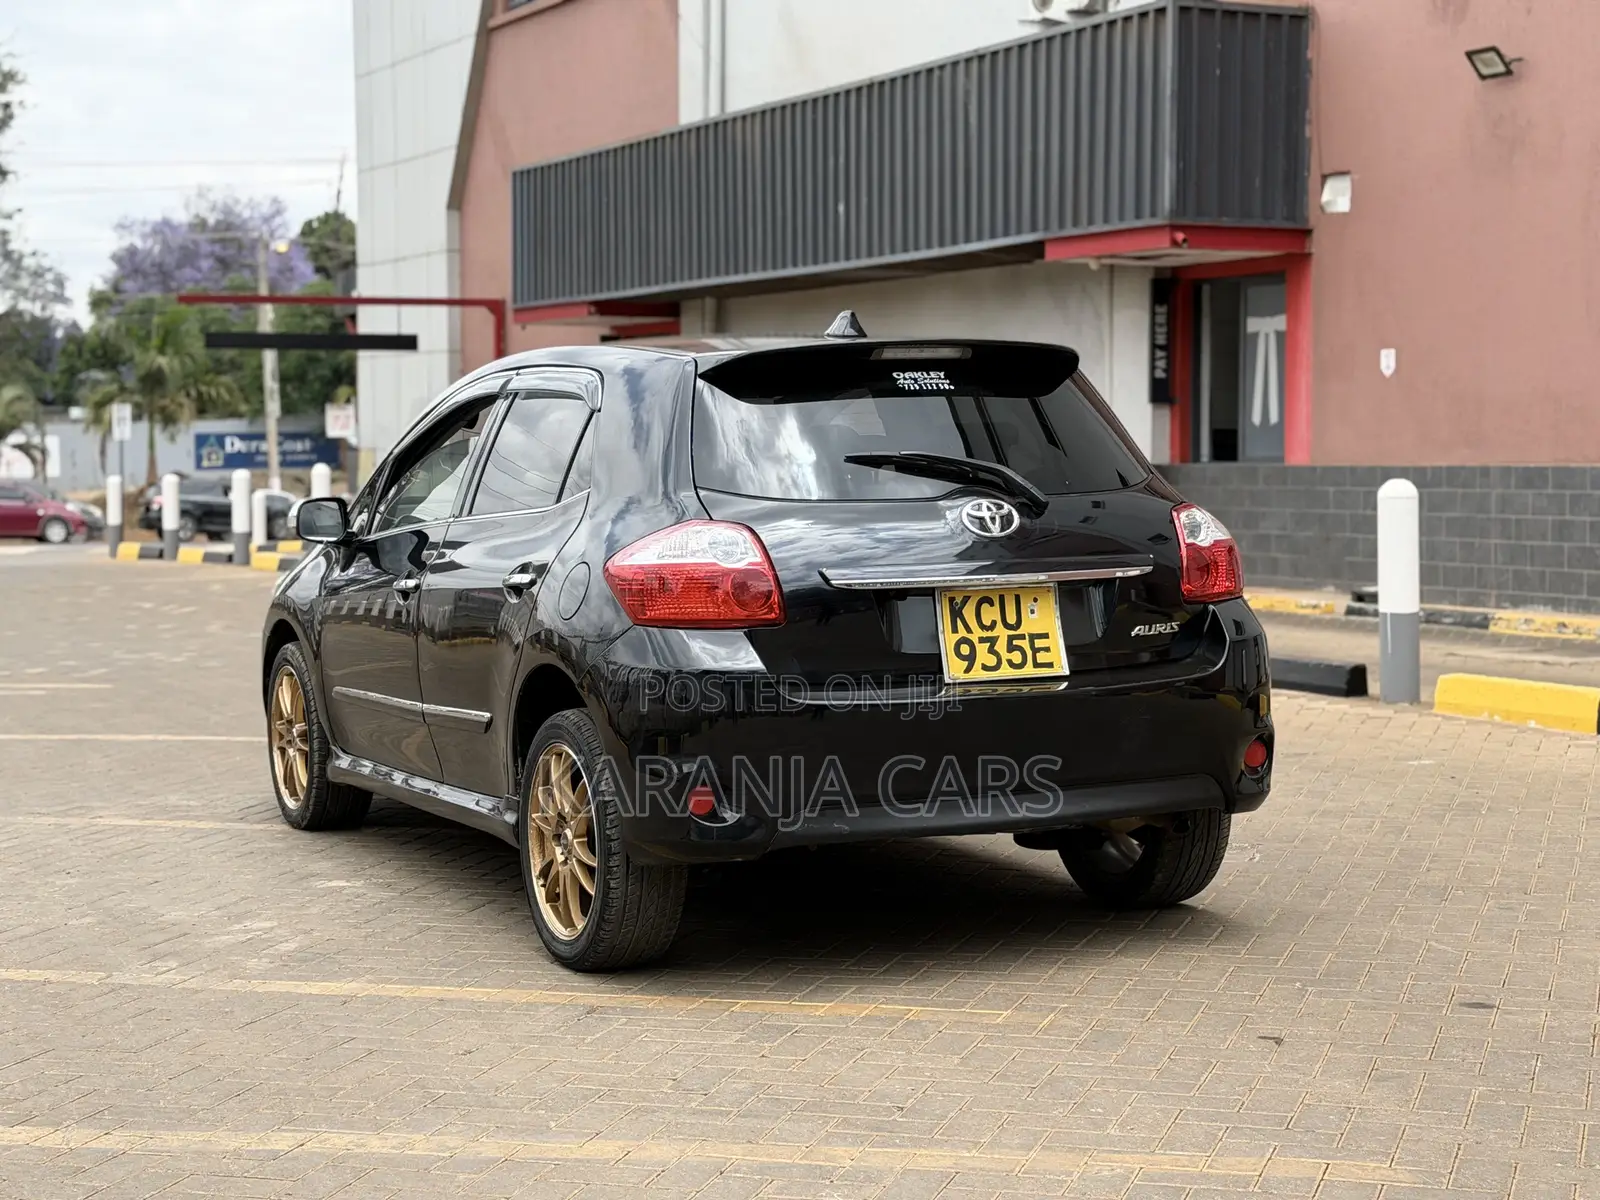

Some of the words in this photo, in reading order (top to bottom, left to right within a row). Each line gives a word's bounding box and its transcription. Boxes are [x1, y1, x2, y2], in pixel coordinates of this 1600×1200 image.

[1153, 303, 1168, 346] HERE
[892, 371, 945, 379] OAKLEY
[1153, 347, 1168, 379] PAY
[949, 594, 1023, 634] KCU
[1131, 621, 1181, 637] AURIS
[953, 633, 1054, 674] 935E
